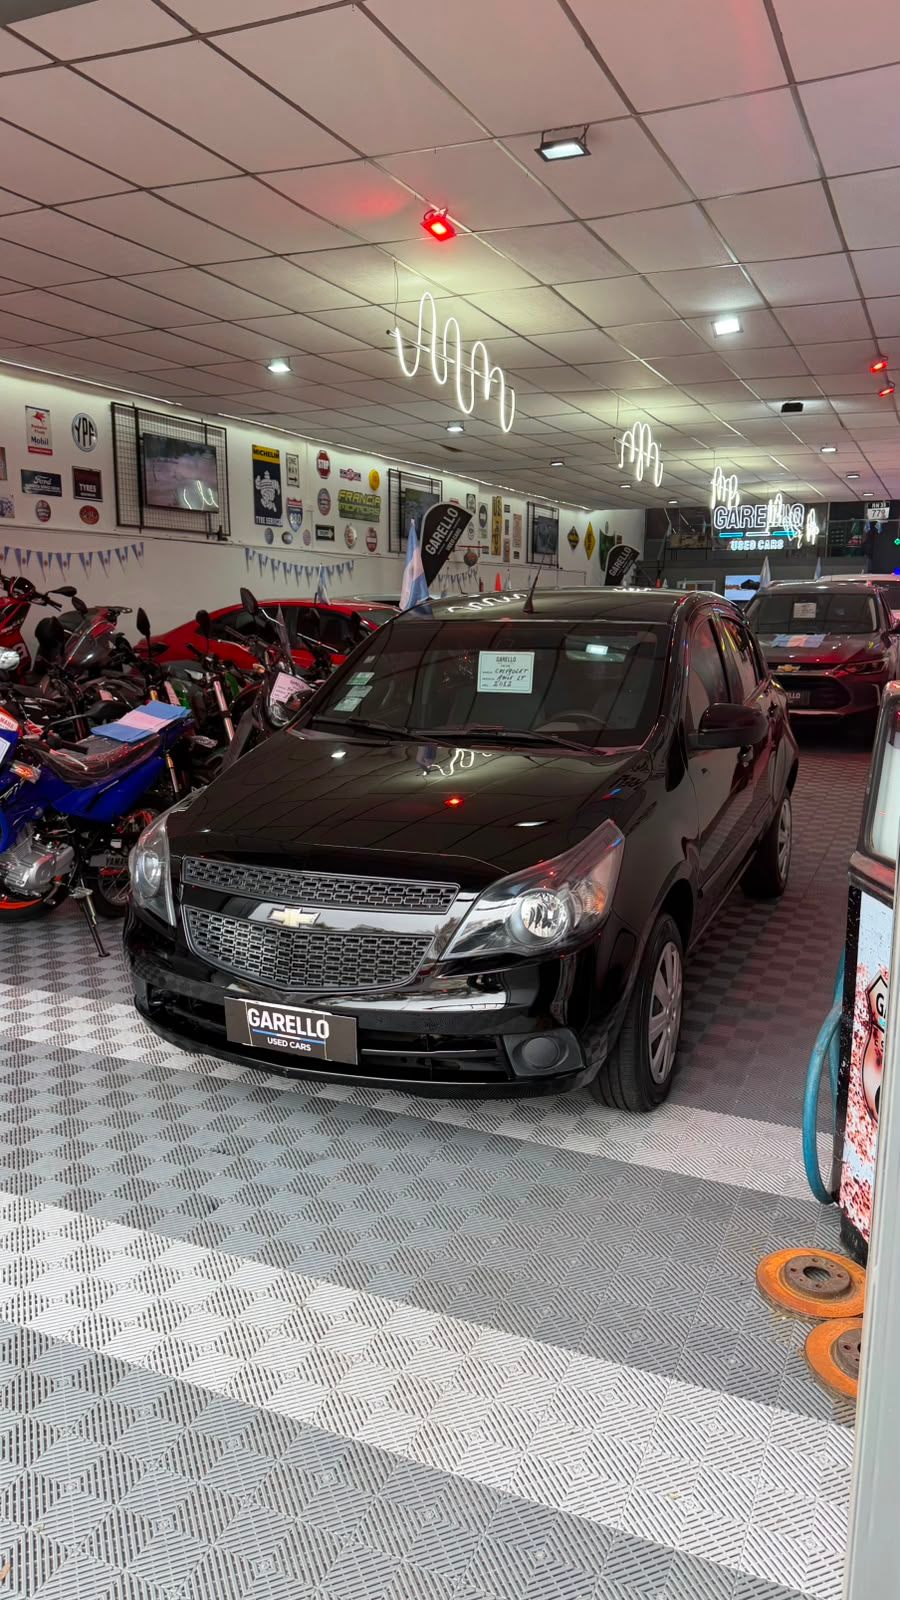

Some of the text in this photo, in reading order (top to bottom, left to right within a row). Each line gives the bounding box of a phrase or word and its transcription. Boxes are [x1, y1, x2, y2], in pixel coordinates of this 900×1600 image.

[75, 417, 95, 447] YPF
[31, 435, 49, 446] Mobil
[253, 449, 280, 459] MICHELIN
[33, 475, 53, 486] Ford
[79, 483, 97, 493] TYRES
[338, 490, 381, 507] FRANCIA
[425, 507, 459, 555] GARELLO
[730, 539, 785, 551] USED CARS
[608, 546, 632, 577] GARELLO
[247, 1007, 330, 1039] GARELLO
[267, 1037, 311, 1051] USED CARS
